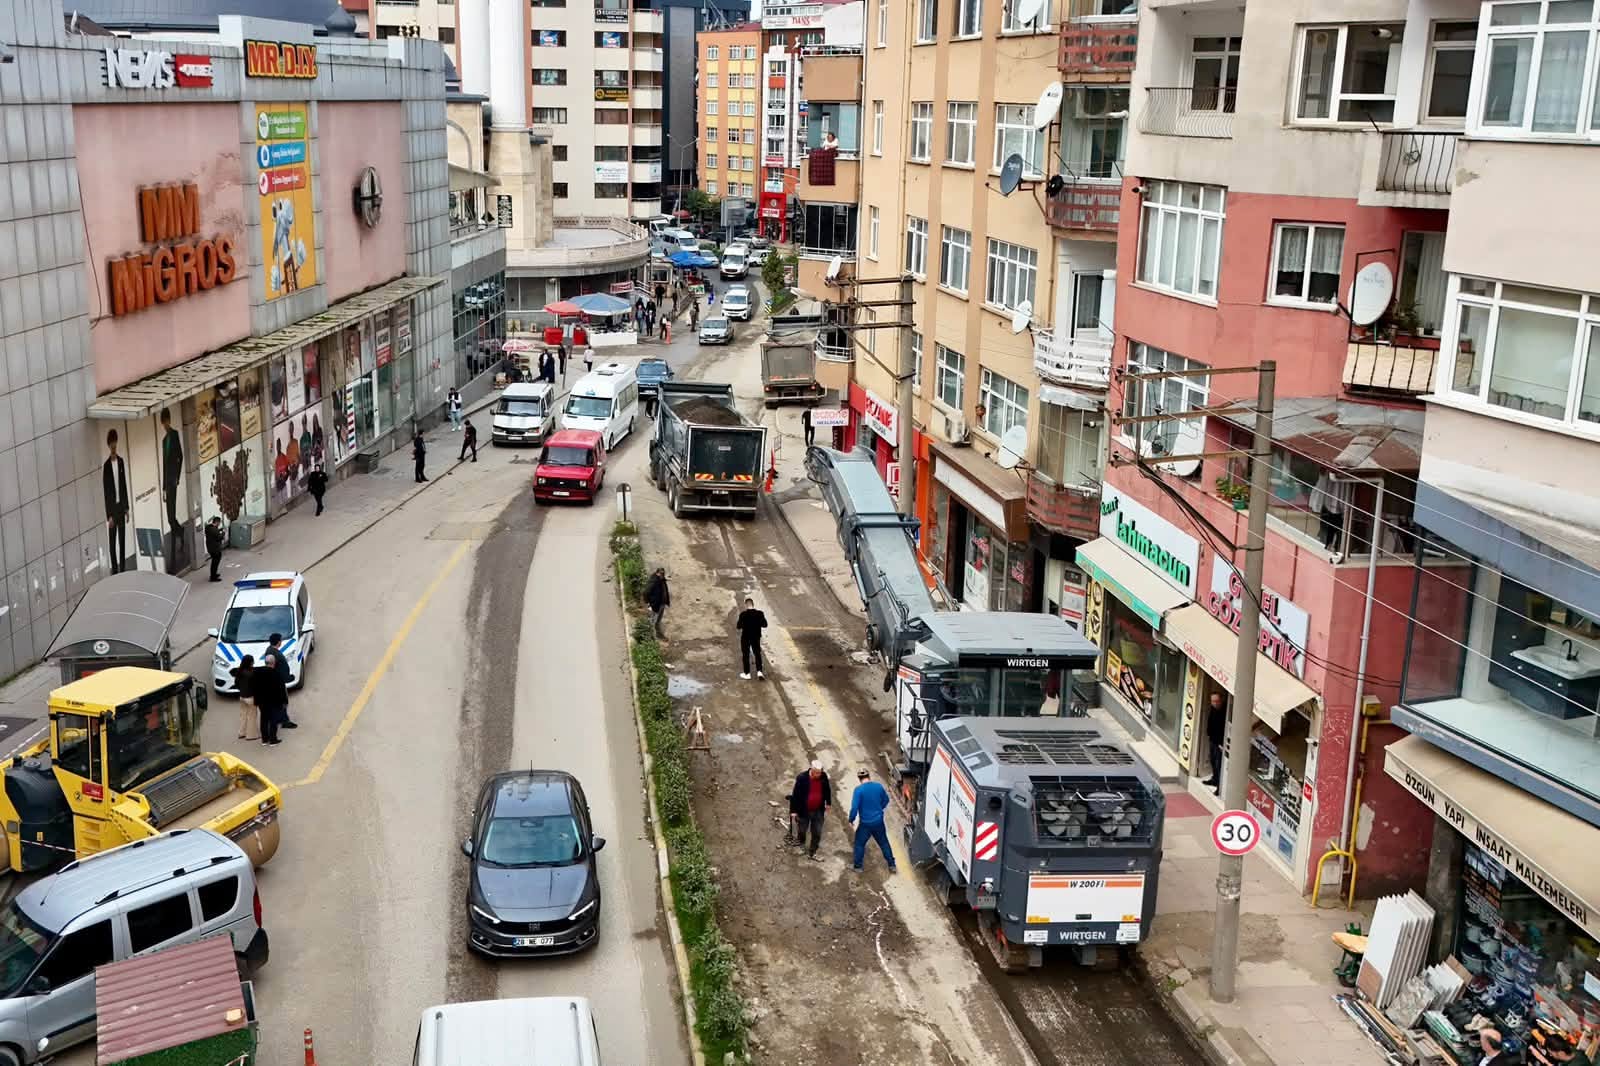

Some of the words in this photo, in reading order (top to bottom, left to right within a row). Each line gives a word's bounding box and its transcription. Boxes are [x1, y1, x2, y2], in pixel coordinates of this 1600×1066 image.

[139, 183, 200, 243] MM
[1116, 511, 1190, 587] lahmacun
[1229, 572, 1280, 625] GEL
[1007, 659, 1049, 667] WIRTGEN
[1444, 801, 1465, 829] YAPI
[1221, 823, 1251, 843] 30
[1059, 930, 1107, 941] WIRTGEN
